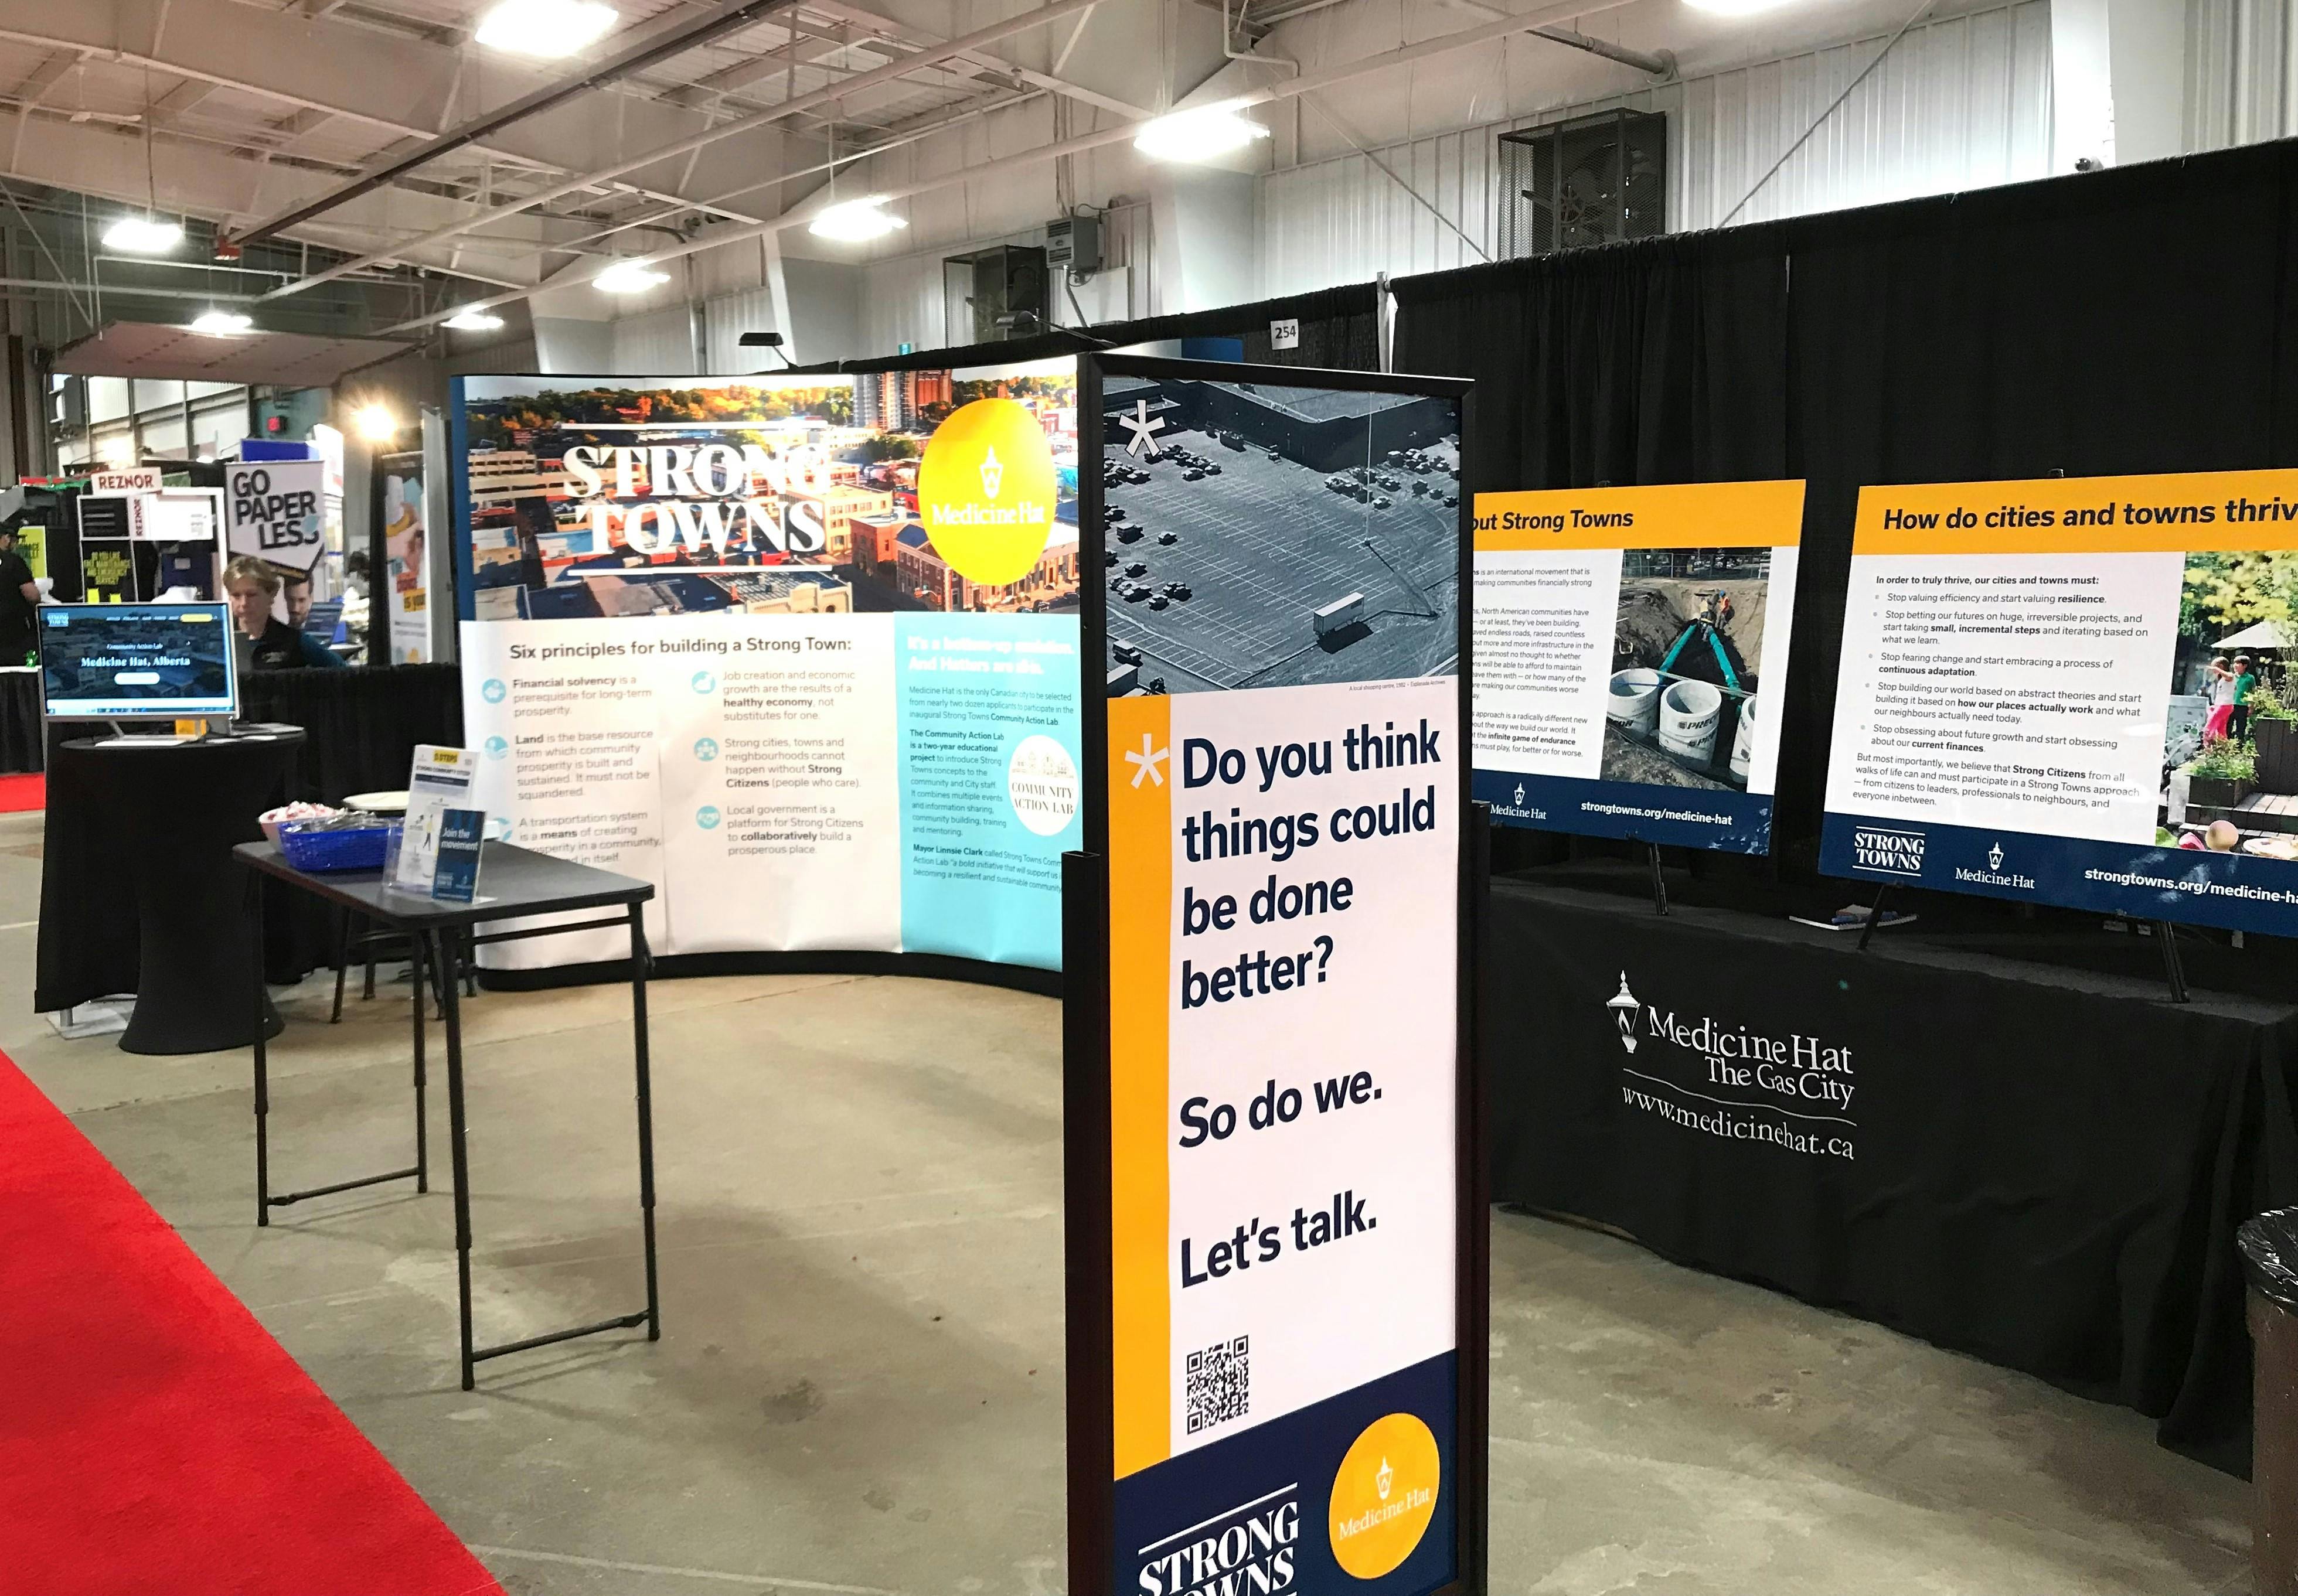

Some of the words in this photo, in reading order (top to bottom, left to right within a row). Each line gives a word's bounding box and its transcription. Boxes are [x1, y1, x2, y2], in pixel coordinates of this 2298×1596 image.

[1275, 325, 1296, 339] 254
[563, 442, 829, 498] STRONG
[98, 475, 155, 489] REZNOR
[233, 469, 271, 497] GO
[134, 499, 144, 536] REZNOR
[235, 490, 316, 526] PAPER
[932, 503, 1017, 526] Medicine
[1018, 501, 1045, 523] Hat
[1884, 509, 1940, 530] How
[1946, 507, 1978, 529] do
[1984, 504, 2055, 528] cities
[2062, 502, 2116, 526] and
[2123, 503, 2216, 525] towns
[2225, 496, 2298, 523] thriv
[575, 501, 825, 554] TOWNS
[1502, 511, 1565, 533] Strong
[1570, 510, 1634, 528] Towns
[1876, 575, 1884, 584] In
[1886, 576, 1909, 584] order
[1911, 576, 1920, 584] to
[1922, 576, 1943, 586] truly
[1944, 575, 1972, 585] thrive,
[1992, 576, 2017, 584] cities
[2019, 575, 2037, 584] and
[2039, 576, 2069, 585] towns
[2071, 576, 2099, 585] must:
[1887, 592, 1907, 602] Stop
[1908, 594, 1938, 603] valuing
[1939, 593, 1981, 604] efficiency
[1982, 594, 1999, 602] and
[2000, 595, 2021, 603] start
[2023, 594, 2055, 605] valuing
[2057, 594, 2106, 603] resilience.
[1904, 623, 1929, 633] taking
[1930, 624, 1956, 633] small,
[1959, 624, 2013, 634] incremental
[2014, 626, 2041, 636] steps
[2042, 626, 2060, 635] and
[2062, 627, 2101, 637] iterating
[2103, 627, 2134, 636] based
[510, 644, 536, 659] Six
[542, 642, 626, 661] principles
[630, 640, 655, 654] for
[659, 638, 727, 654] building
[732, 642, 741, 652] a
[746, 637, 801, 654] Strong
[805, 637, 851, 650] Town:
[81, 657, 127, 667] Medicine
[129, 657, 151, 667] Hat,
[153, 656, 190, 666] Alberta
[1878, 665, 1926, 674] continuous
[1928, 667, 1977, 677] adaptation.
[512, 677, 564, 689] Financial
[567, 677, 617, 687] solvency
[723, 698, 764, 709] healthy
[765, 699, 815, 708] economy,
[818, 698, 834, 706] not
[724, 738, 760, 749] Strong
[762, 738, 791, 748] cities,
[794, 738, 824, 747] towns
[826, 738, 845, 747] and
[909, 729, 924, 737] The
[924, 729, 967, 740] Community
[968, 731, 992, 740] Action
[993, 732, 1005, 741] Lab
[1488, 732, 1511, 741] infinite
[1540, 736, 1576, 745] endurance
[1871, 736, 1895, 746] about
[1911, 741, 1945, 749] current
[1946, 741, 1985, 752] finances.
[1183, 737, 1246, 789] Do
[1255, 741, 1332, 792] you
[1342, 718, 1441, 772] think
[726, 766, 765, 776] happen
[768, 765, 805, 773] without
[808, 763, 842, 776] Strong
[726, 778, 770, 788] Citizens
[772, 777, 809, 789] (people
[812, 777, 833, 787] who
[835, 779, 862, 788] care).
[1012, 782, 1074, 799] COMMUNITY
[1014, 796, 1049, 812] ACTION
[1053, 802, 1073, 815] LAB
[1490, 804, 1530, 819] Medicine
[1531, 809, 1547, 820] Hat
[1581, 802, 1733, 826] strongtowns.org/medicine-hat
[458, 828, 470, 839] the
[1182, 807, 1319, 862] things
[1330, 785, 1435, 843] could
[913, 843, 935, 854] Mayor
[935, 845, 962, 855] Linnsie
[963, 847, 983, 856] Clark
[984, 850, 1003, 858] called
[1003, 851, 1022, 863] Strong
[1023, 854, 1042, 864] Towns
[1854, 833, 1925, 855] STRONG
[1856, 848, 1921, 871] TOWNS
[1955, 867, 2011, 886] Medicine
[2013, 874, 2035, 889] Hat
[2085, 868, 2298, 904] strongtowns.org/medicine-h
[1183, 886, 1237, 936] be
[1249, 874, 1353, 925] done
[1182, 935, 1333, 1010] better?
[1647, 1005, 1787, 1065] Medicine
[1790, 1034, 1854, 1074] Hat
[1705, 1055, 1752, 1086] The
[1757, 1063, 1796, 1096] Gas
[1799, 1072, 1855, 1110] City
[1179, 1096, 1237, 1148] So
[1248, 1079, 1302, 1130] do
[1313, 1070, 1383, 1114] we.
[1623, 1086, 1854, 1160] www.medicinehat.ca
[1181, 1216, 1281, 1289] Let's
[1291, 1189, 1377, 1251] talk.
[1339, 1500, 1405, 1541] Medicine
[1406, 1487, 1431, 1510] Hat
[1139, 1501, 1300, 1596] STRONG
